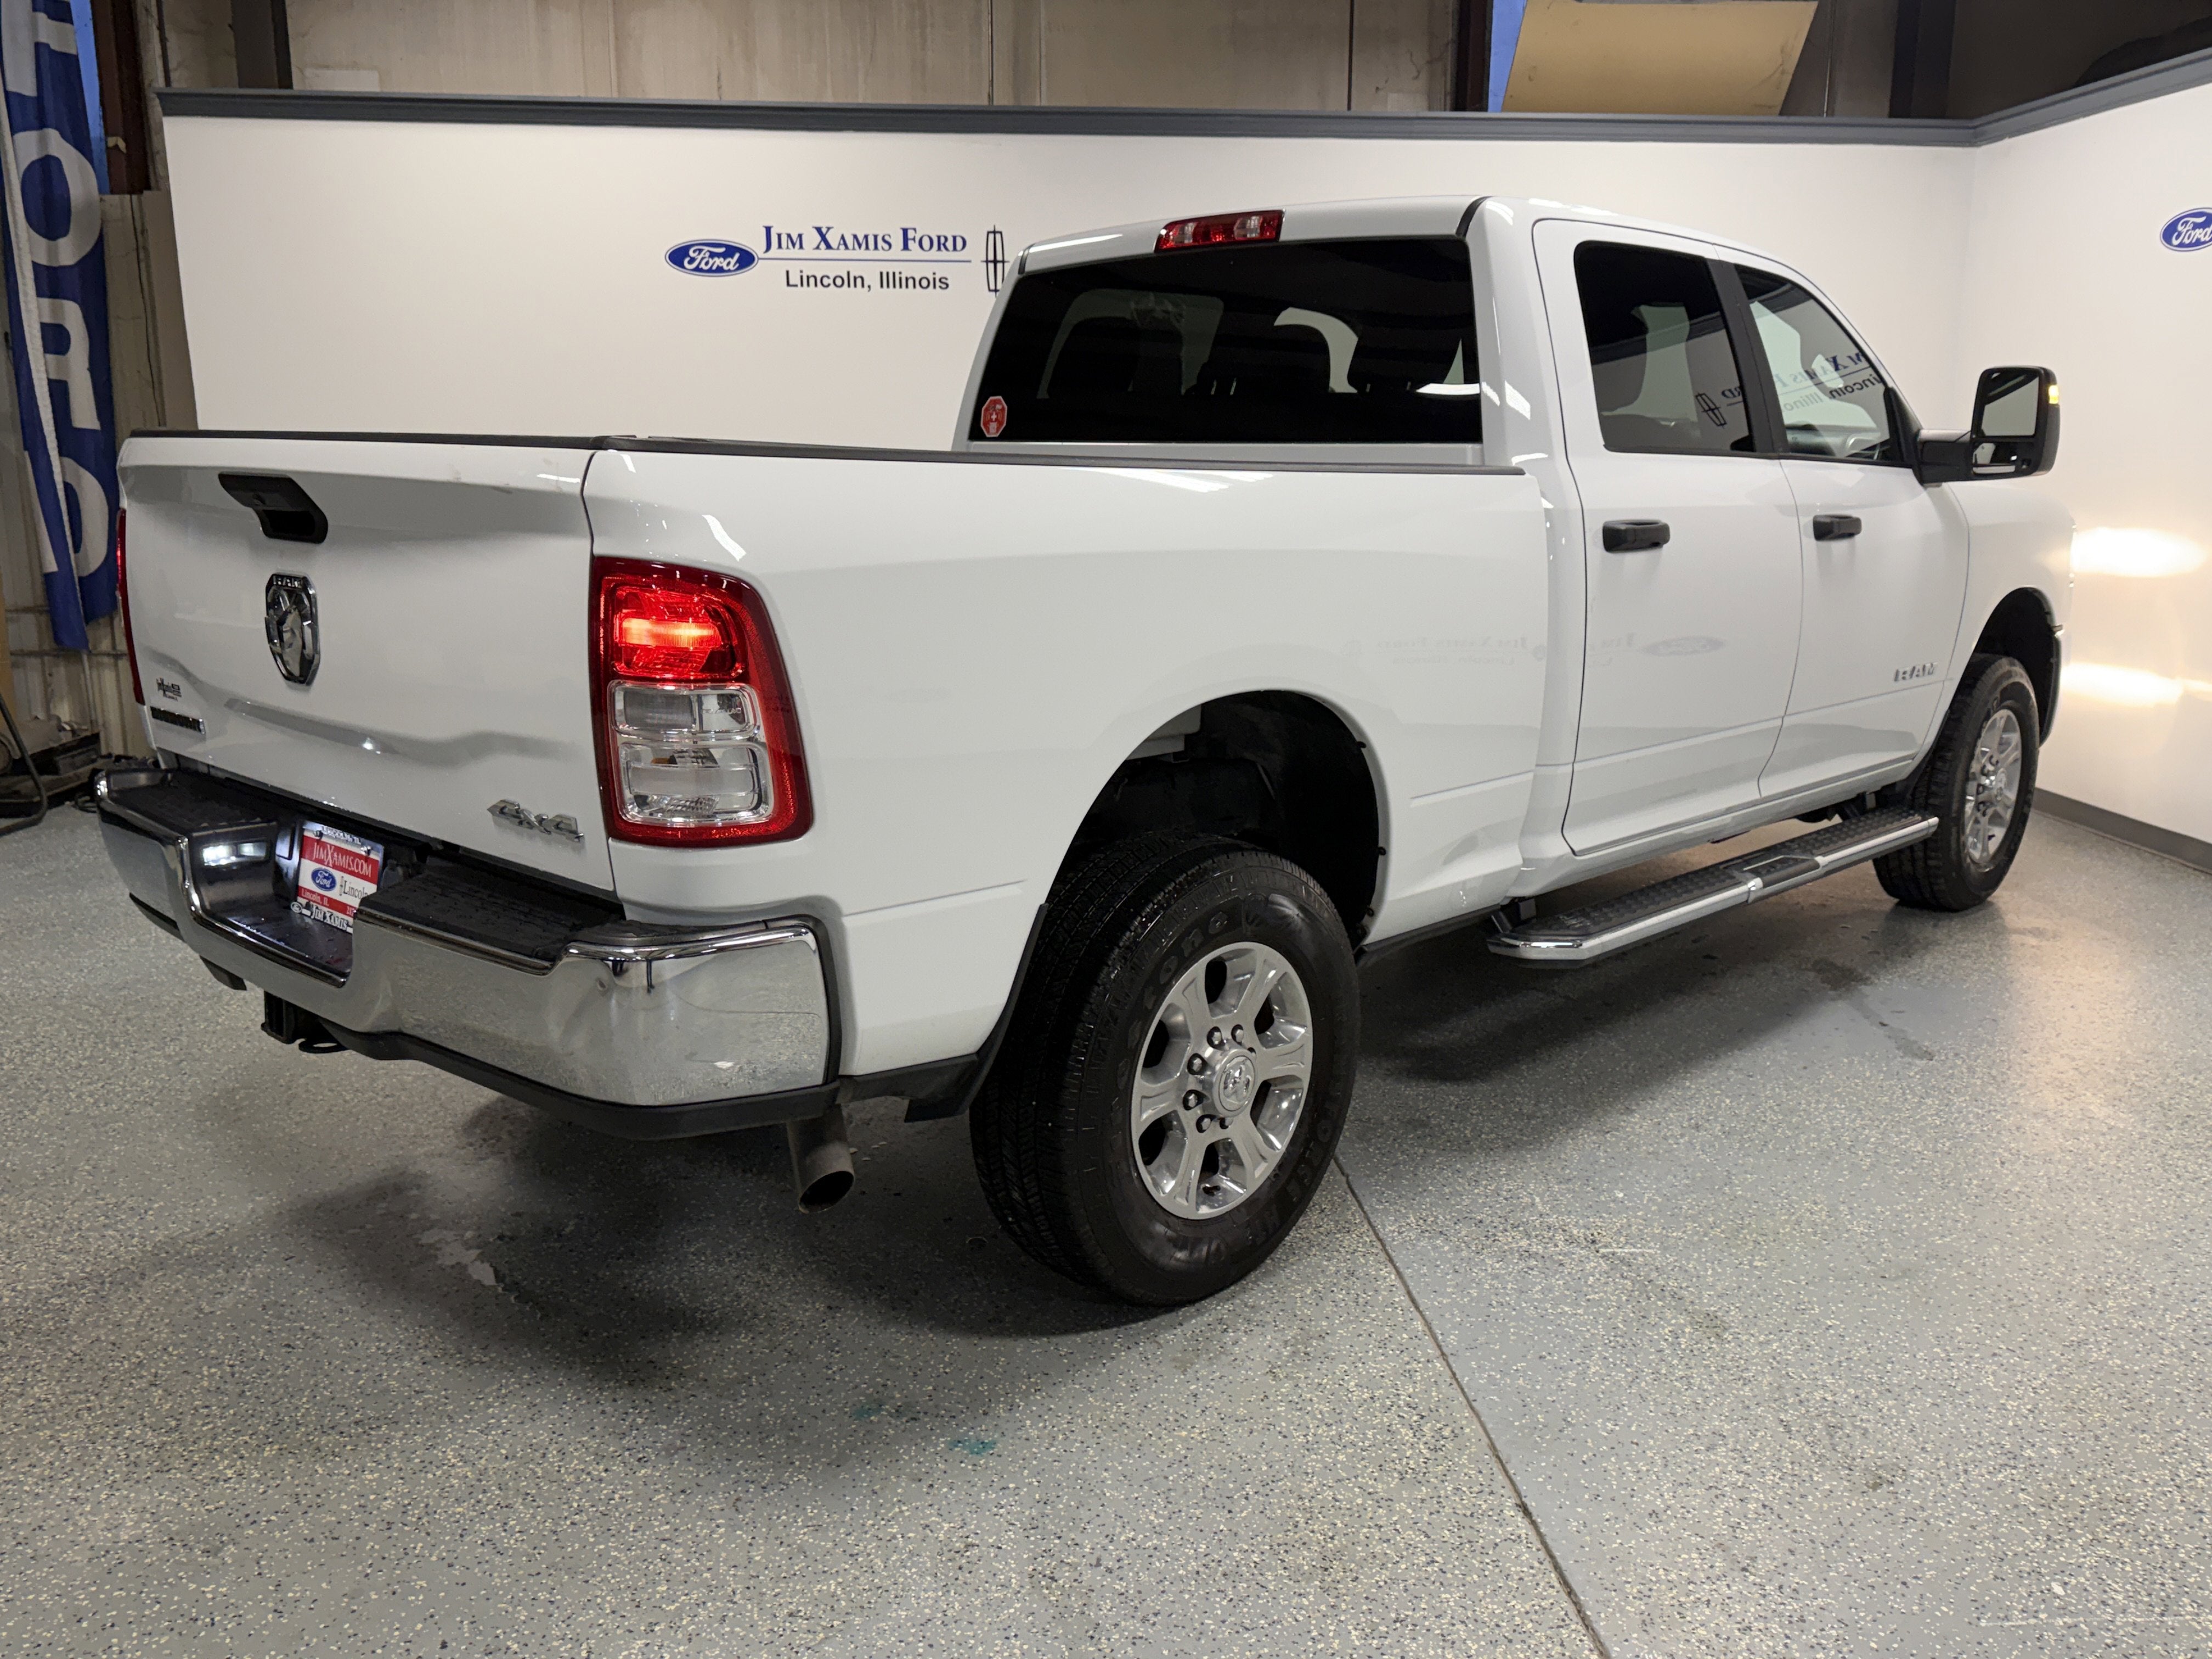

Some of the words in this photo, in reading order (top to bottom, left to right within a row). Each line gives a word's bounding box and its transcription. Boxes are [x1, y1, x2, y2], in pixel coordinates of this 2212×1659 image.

[2172, 216, 2212, 245] Ford
[684, 245, 740, 270] Ford
[785, 269, 872, 292] Lincoln,
[879, 270, 949, 290] Illinois
[1894, 663, 1937, 681] RAM
[315, 870, 332, 888] Ford
